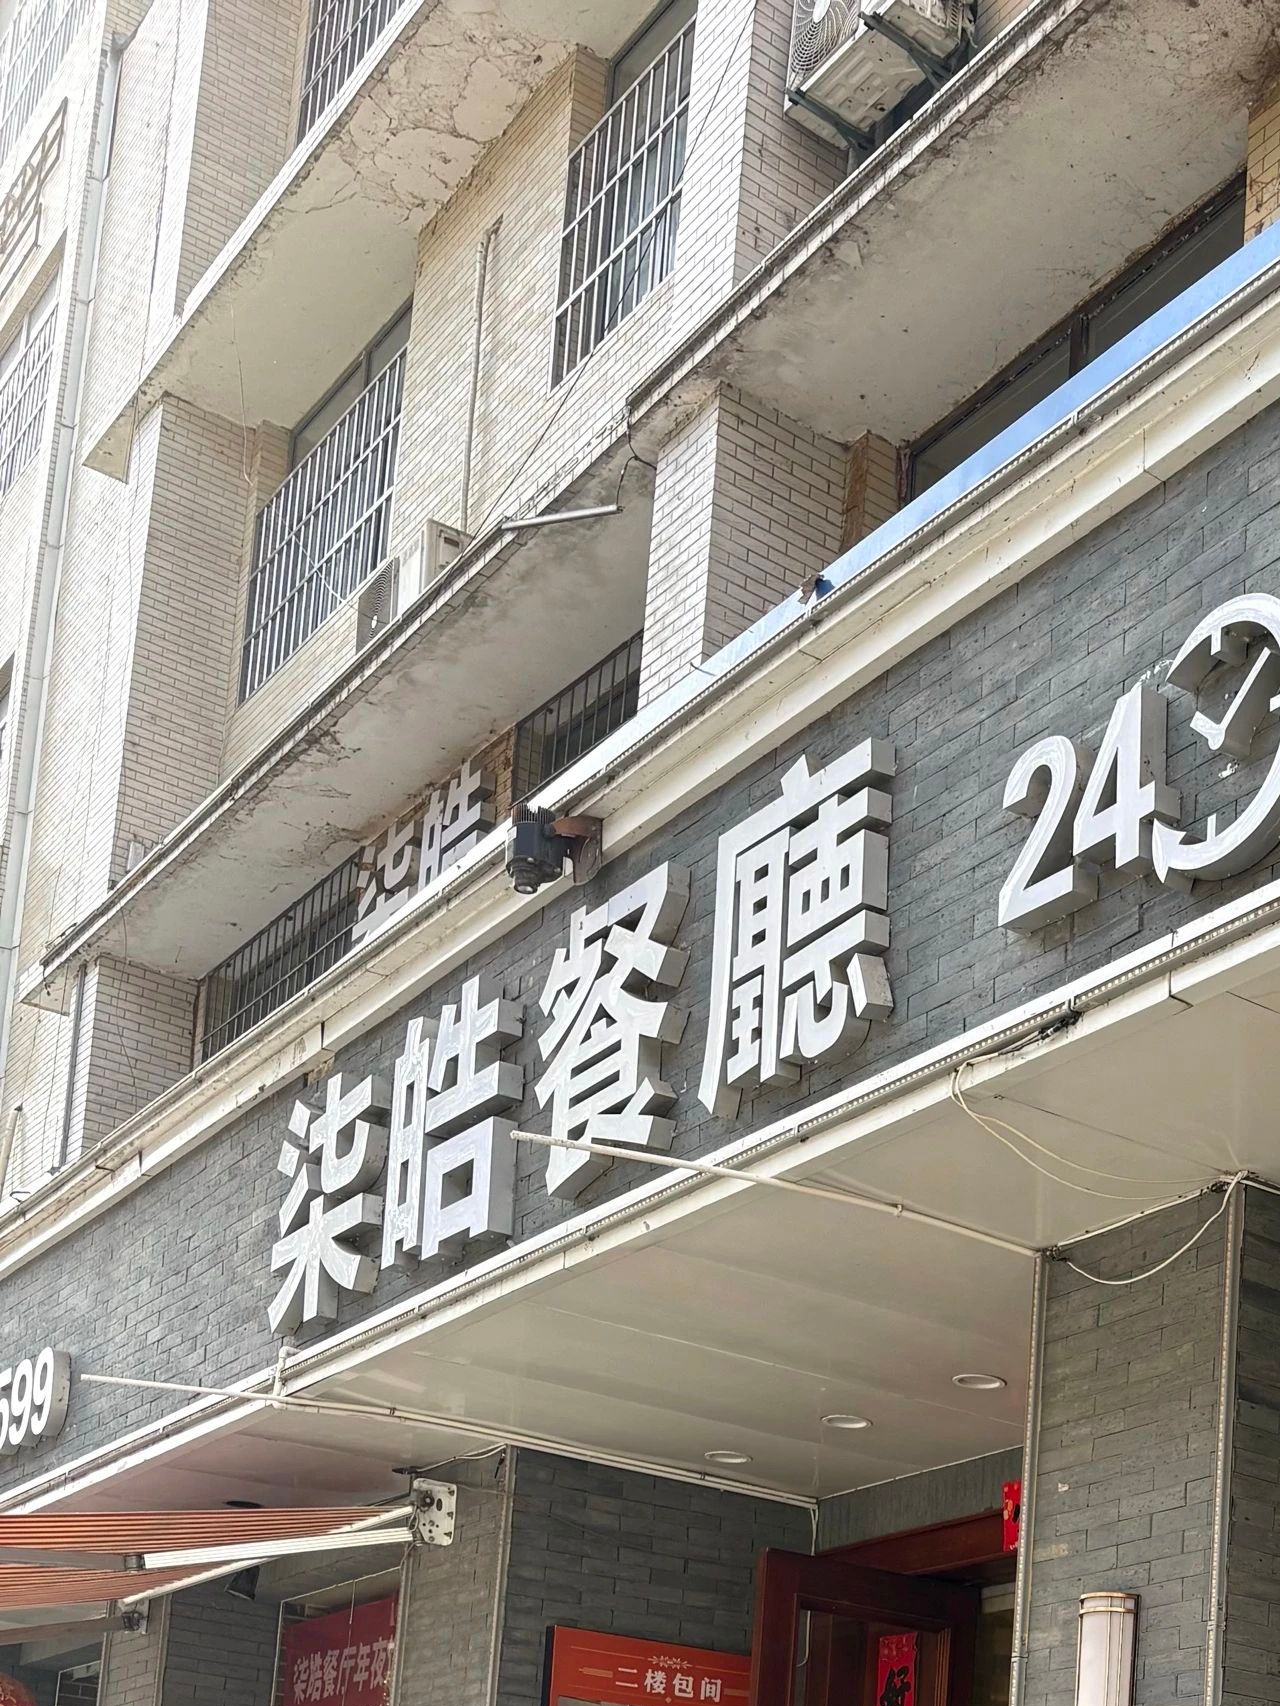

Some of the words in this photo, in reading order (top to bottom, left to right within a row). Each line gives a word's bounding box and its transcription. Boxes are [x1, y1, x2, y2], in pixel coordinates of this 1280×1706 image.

[267, 737, 893, 1334] 柒皓餐廳
[615, 1667, 723, 1703] 二楼包间
